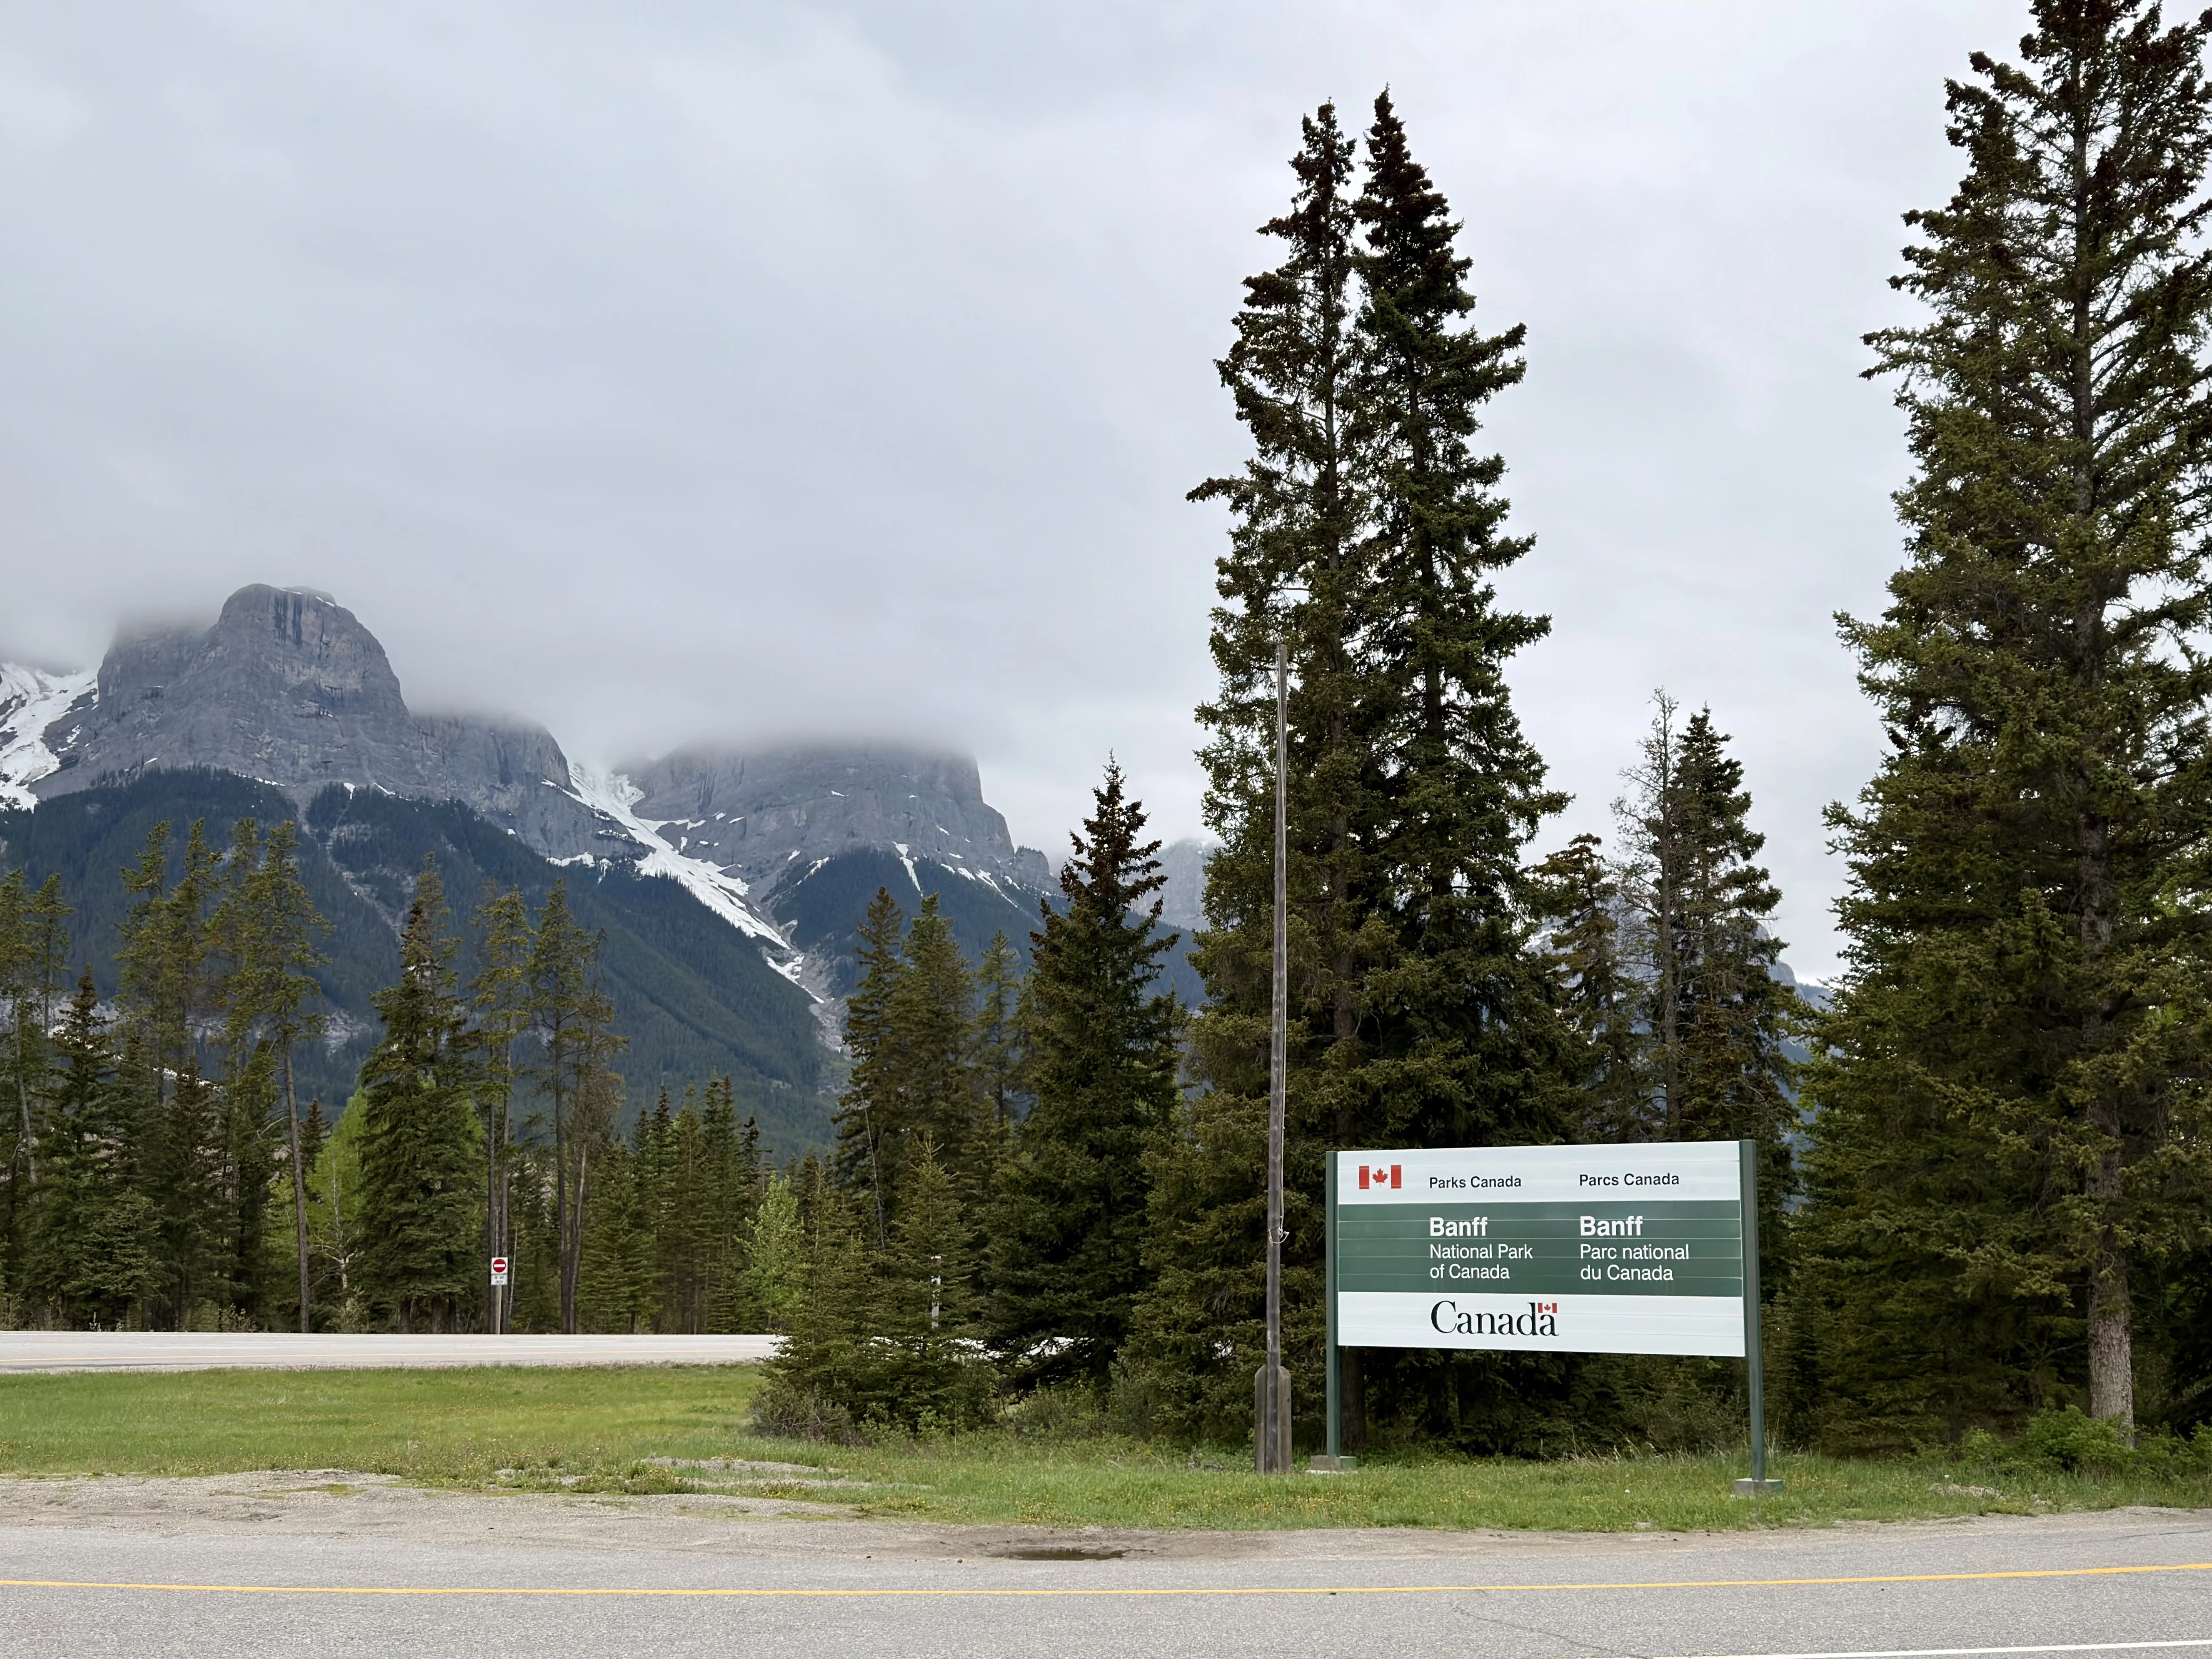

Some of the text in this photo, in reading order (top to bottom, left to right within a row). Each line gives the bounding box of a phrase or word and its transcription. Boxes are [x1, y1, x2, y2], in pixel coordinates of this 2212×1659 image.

[1430, 1175, 1521, 1188] Parks Canada
[1580, 1173, 1679, 1186] Parcs Canada
[1430, 1216, 1488, 1237] Banff
[1580, 1215, 1643, 1237] Banff
[1430, 1244, 1533, 1259] National Park
[1580, 1244, 1689, 1260] Parc national
[1430, 1263, 1510, 1279] of Canada
[1580, 1264, 1674, 1281] du Canada
[1431, 1300, 1559, 1336] Canada
